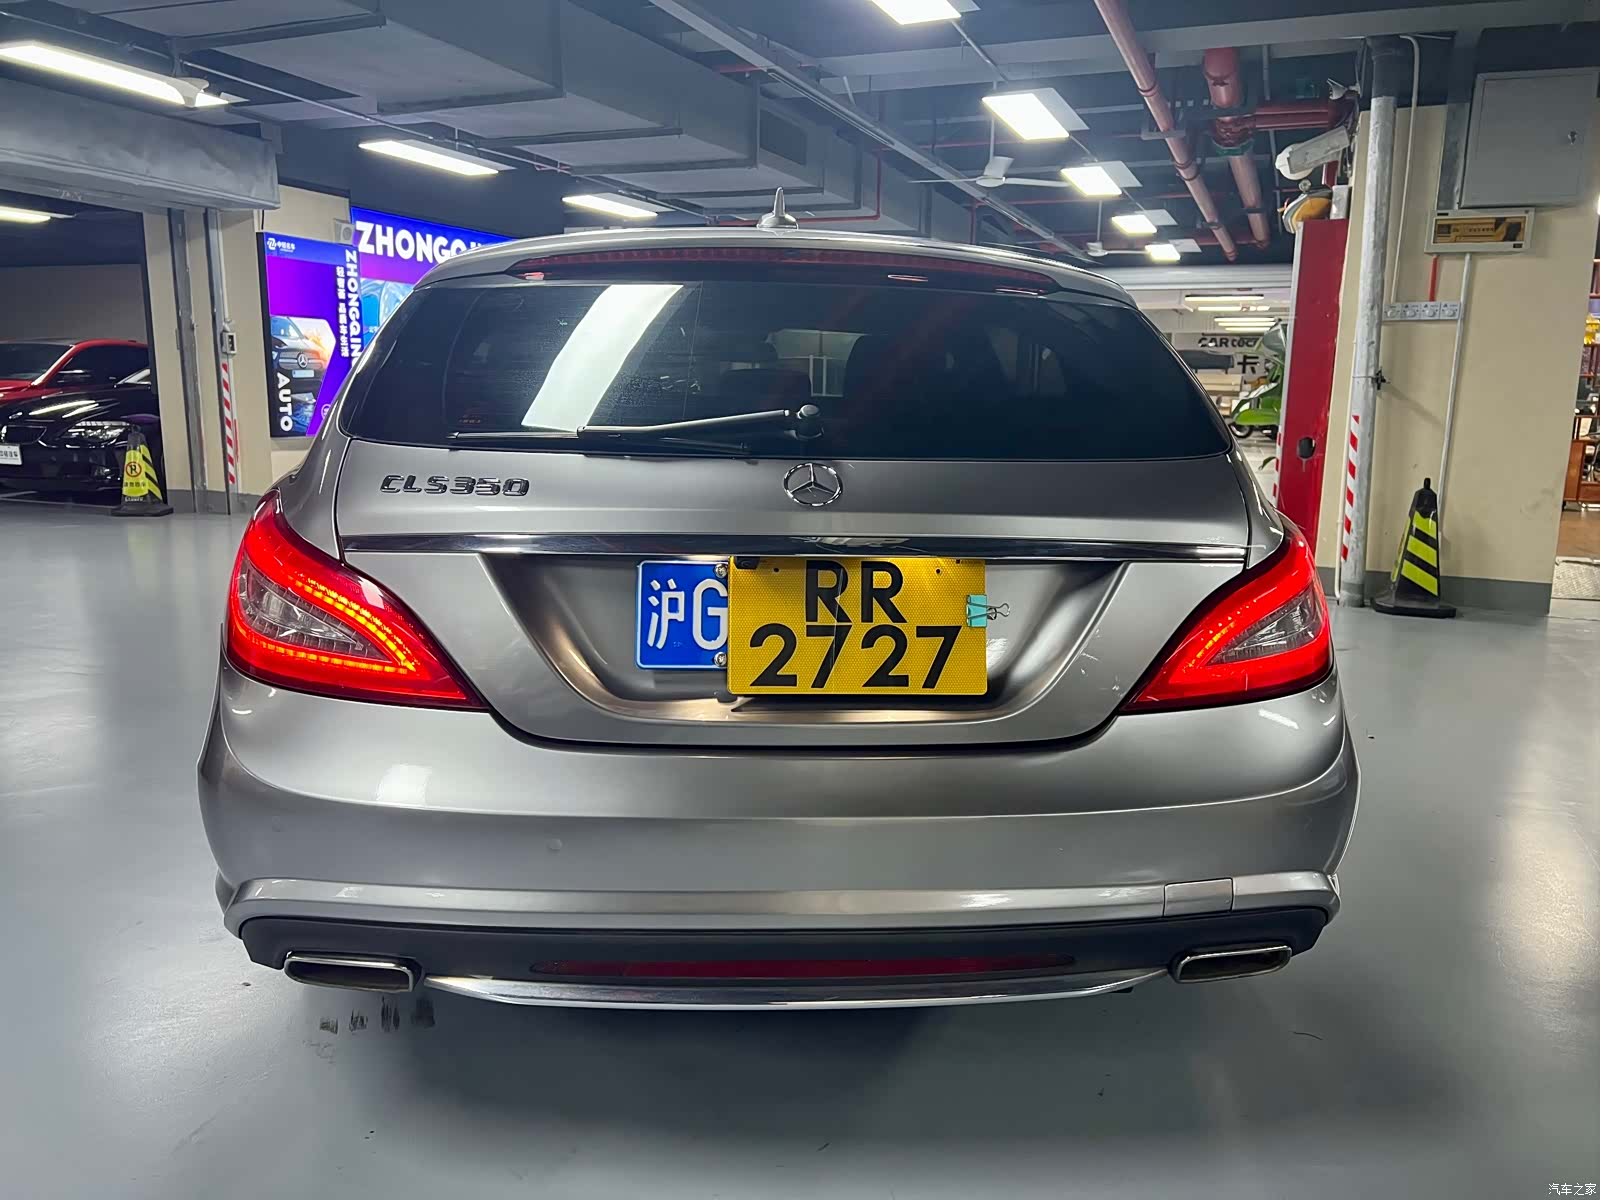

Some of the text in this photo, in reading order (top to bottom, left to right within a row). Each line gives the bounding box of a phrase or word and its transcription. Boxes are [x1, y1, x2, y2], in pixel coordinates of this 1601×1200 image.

[356, 221, 483, 264] ZHONG
[1198, 337, 1229, 348] CAR
[276, 371, 293, 432] AUTO
[379, 474, 530, 497] CLS350
[805, 560, 907, 624] RR
[749, 623, 962, 690] 2727
